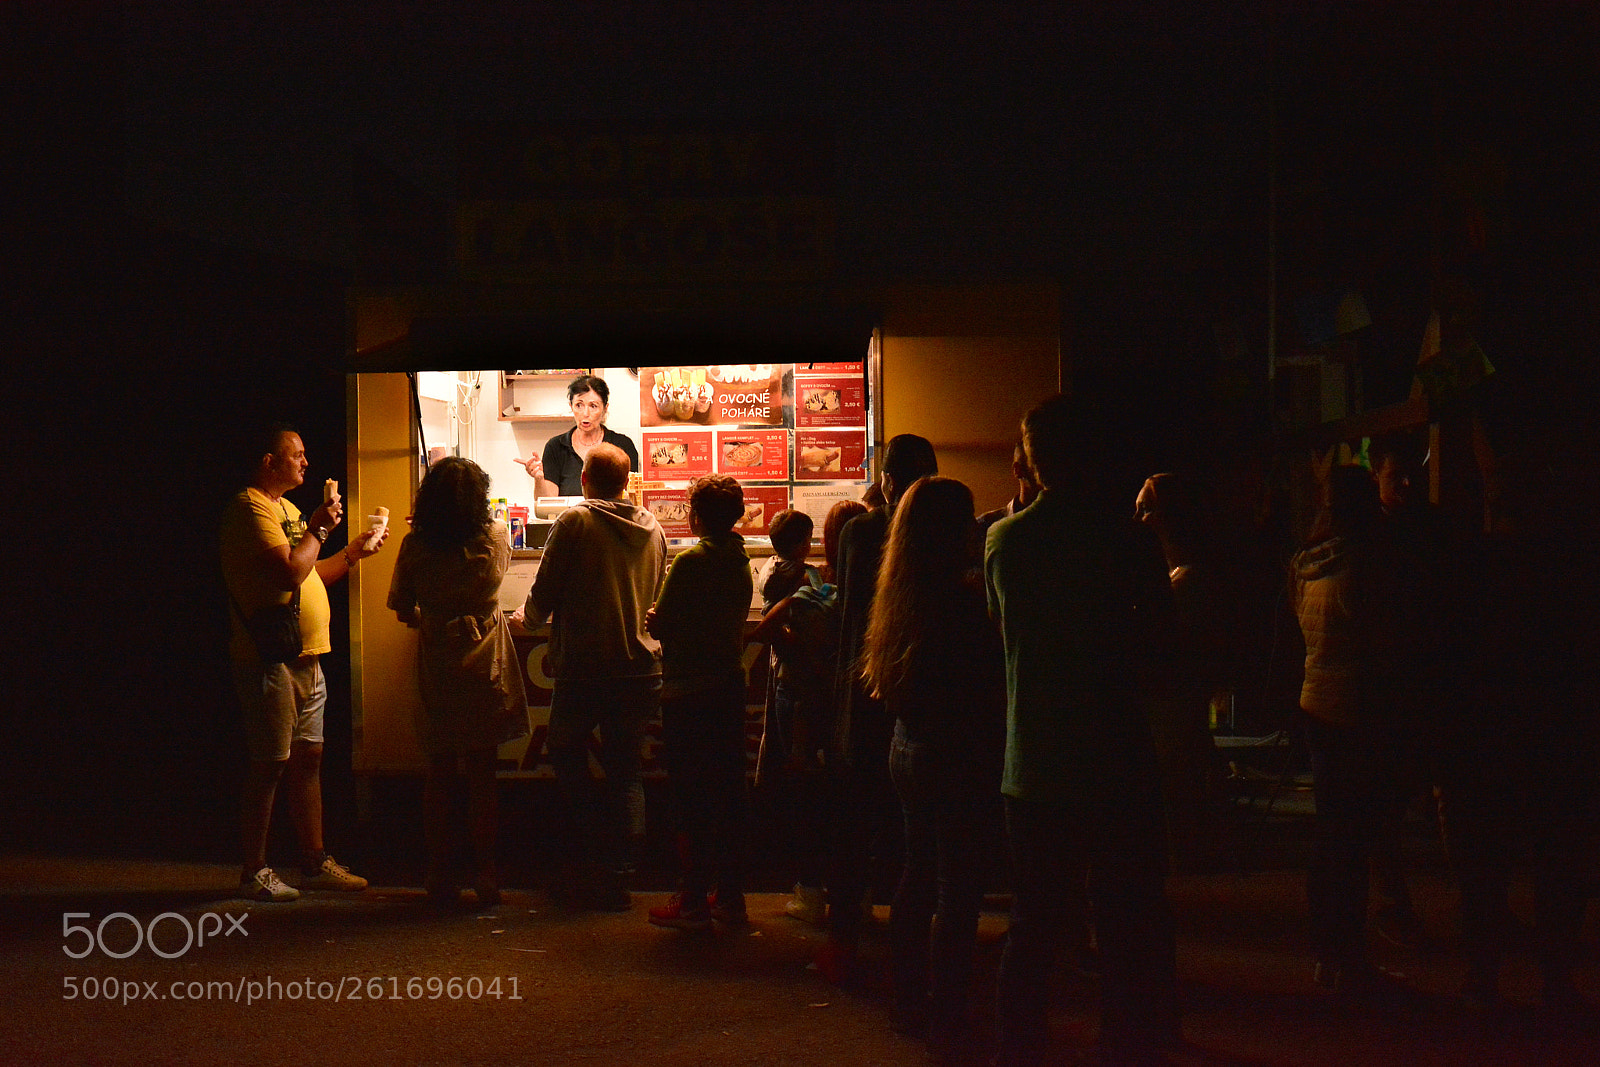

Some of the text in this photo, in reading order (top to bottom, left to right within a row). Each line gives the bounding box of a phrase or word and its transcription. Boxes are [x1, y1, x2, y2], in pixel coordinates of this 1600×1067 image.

[523, 133, 761, 181] GOFRY
[718, 388, 770, 404] OVOCNÉ
[721, 404, 771, 418] POHÁRE
